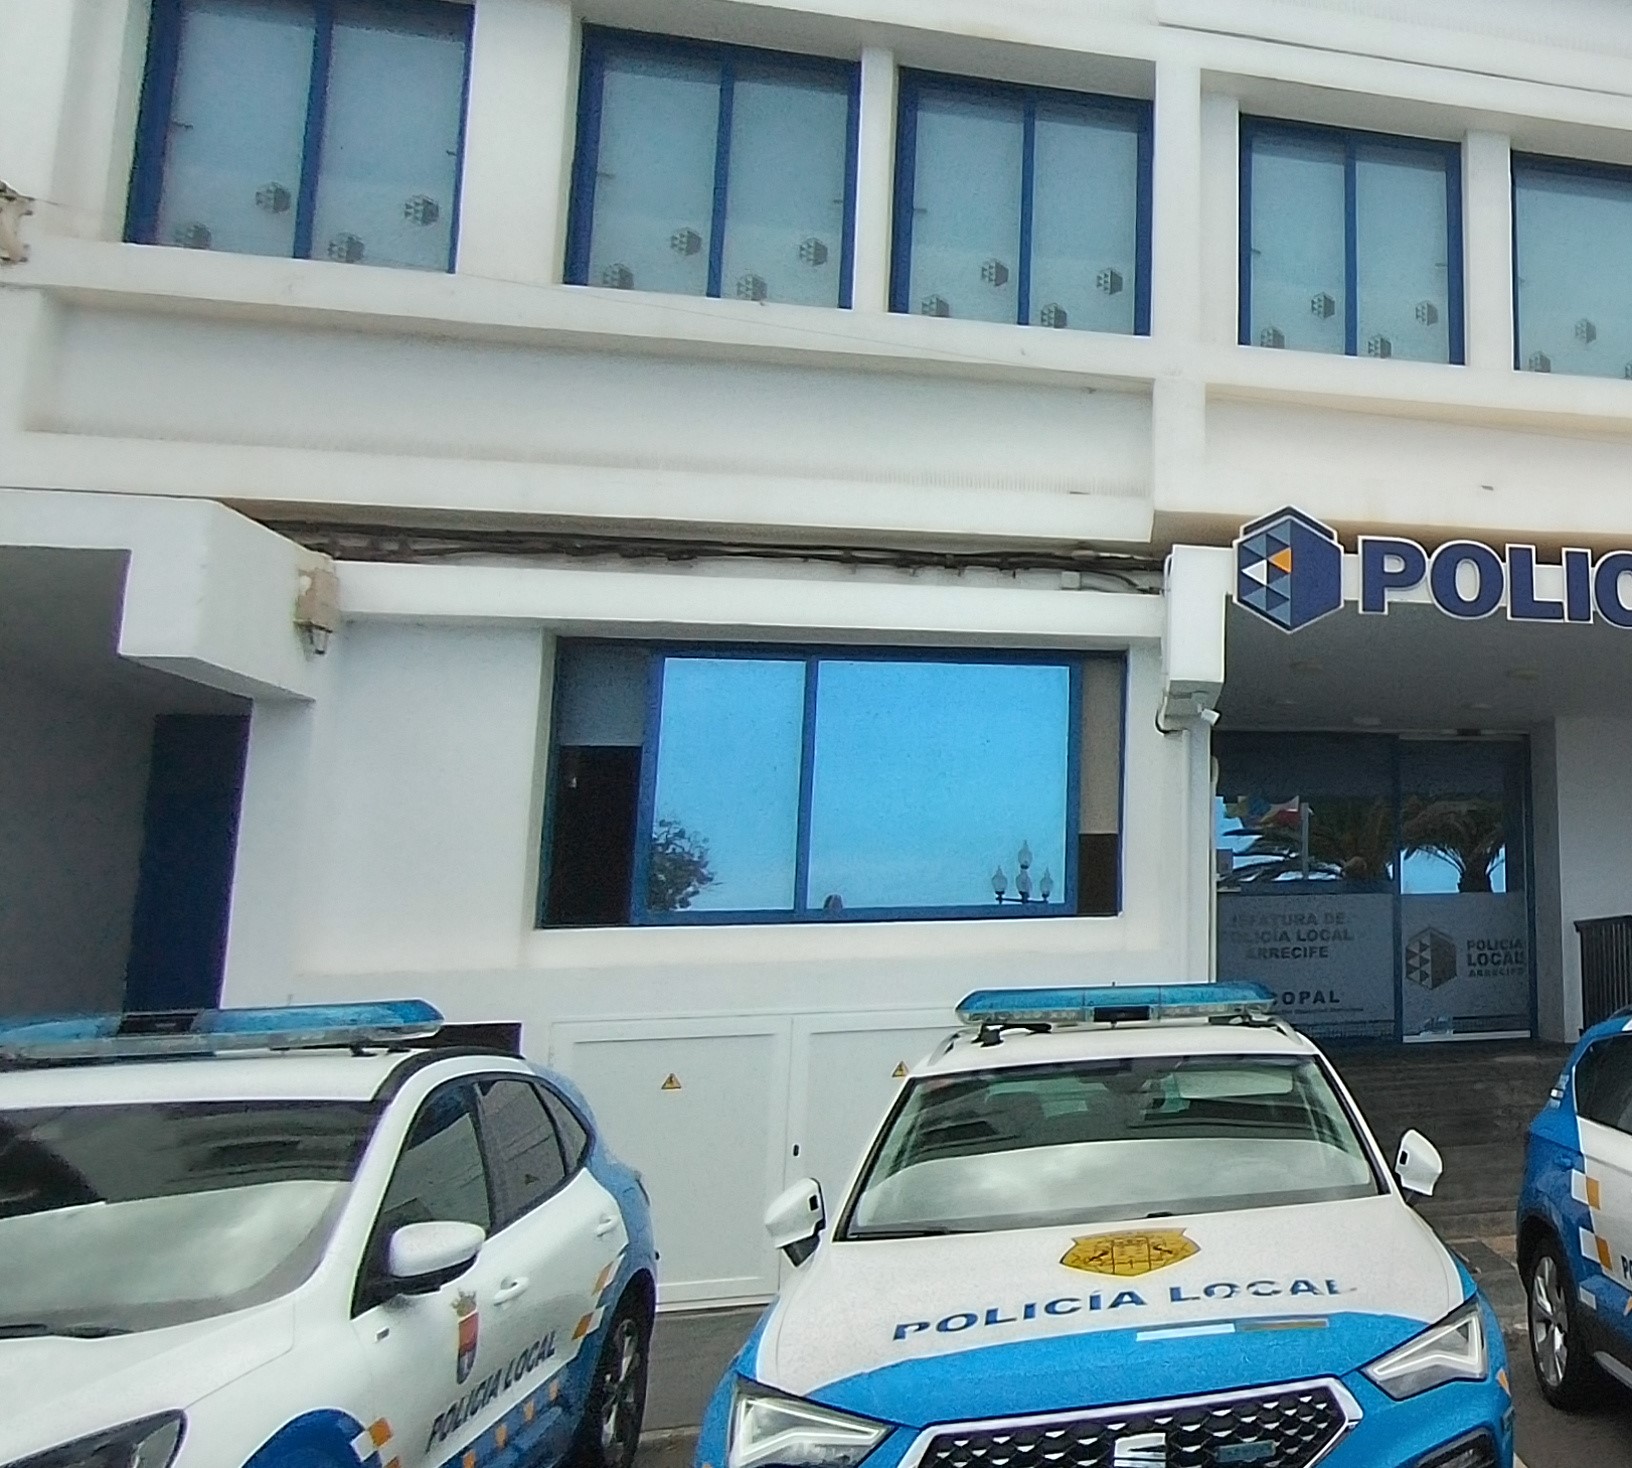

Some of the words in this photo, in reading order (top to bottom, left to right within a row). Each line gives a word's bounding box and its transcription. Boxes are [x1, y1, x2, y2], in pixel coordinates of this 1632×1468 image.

[1296, 928, 1355, 943] LOCAL
[1245, 945, 1329, 960] ARRECIFE
[1466, 950, 1525, 967] LOCAL
[1169, 1278, 1357, 1301] LOCAL
[503, 1330, 556, 1391] LOCAL
